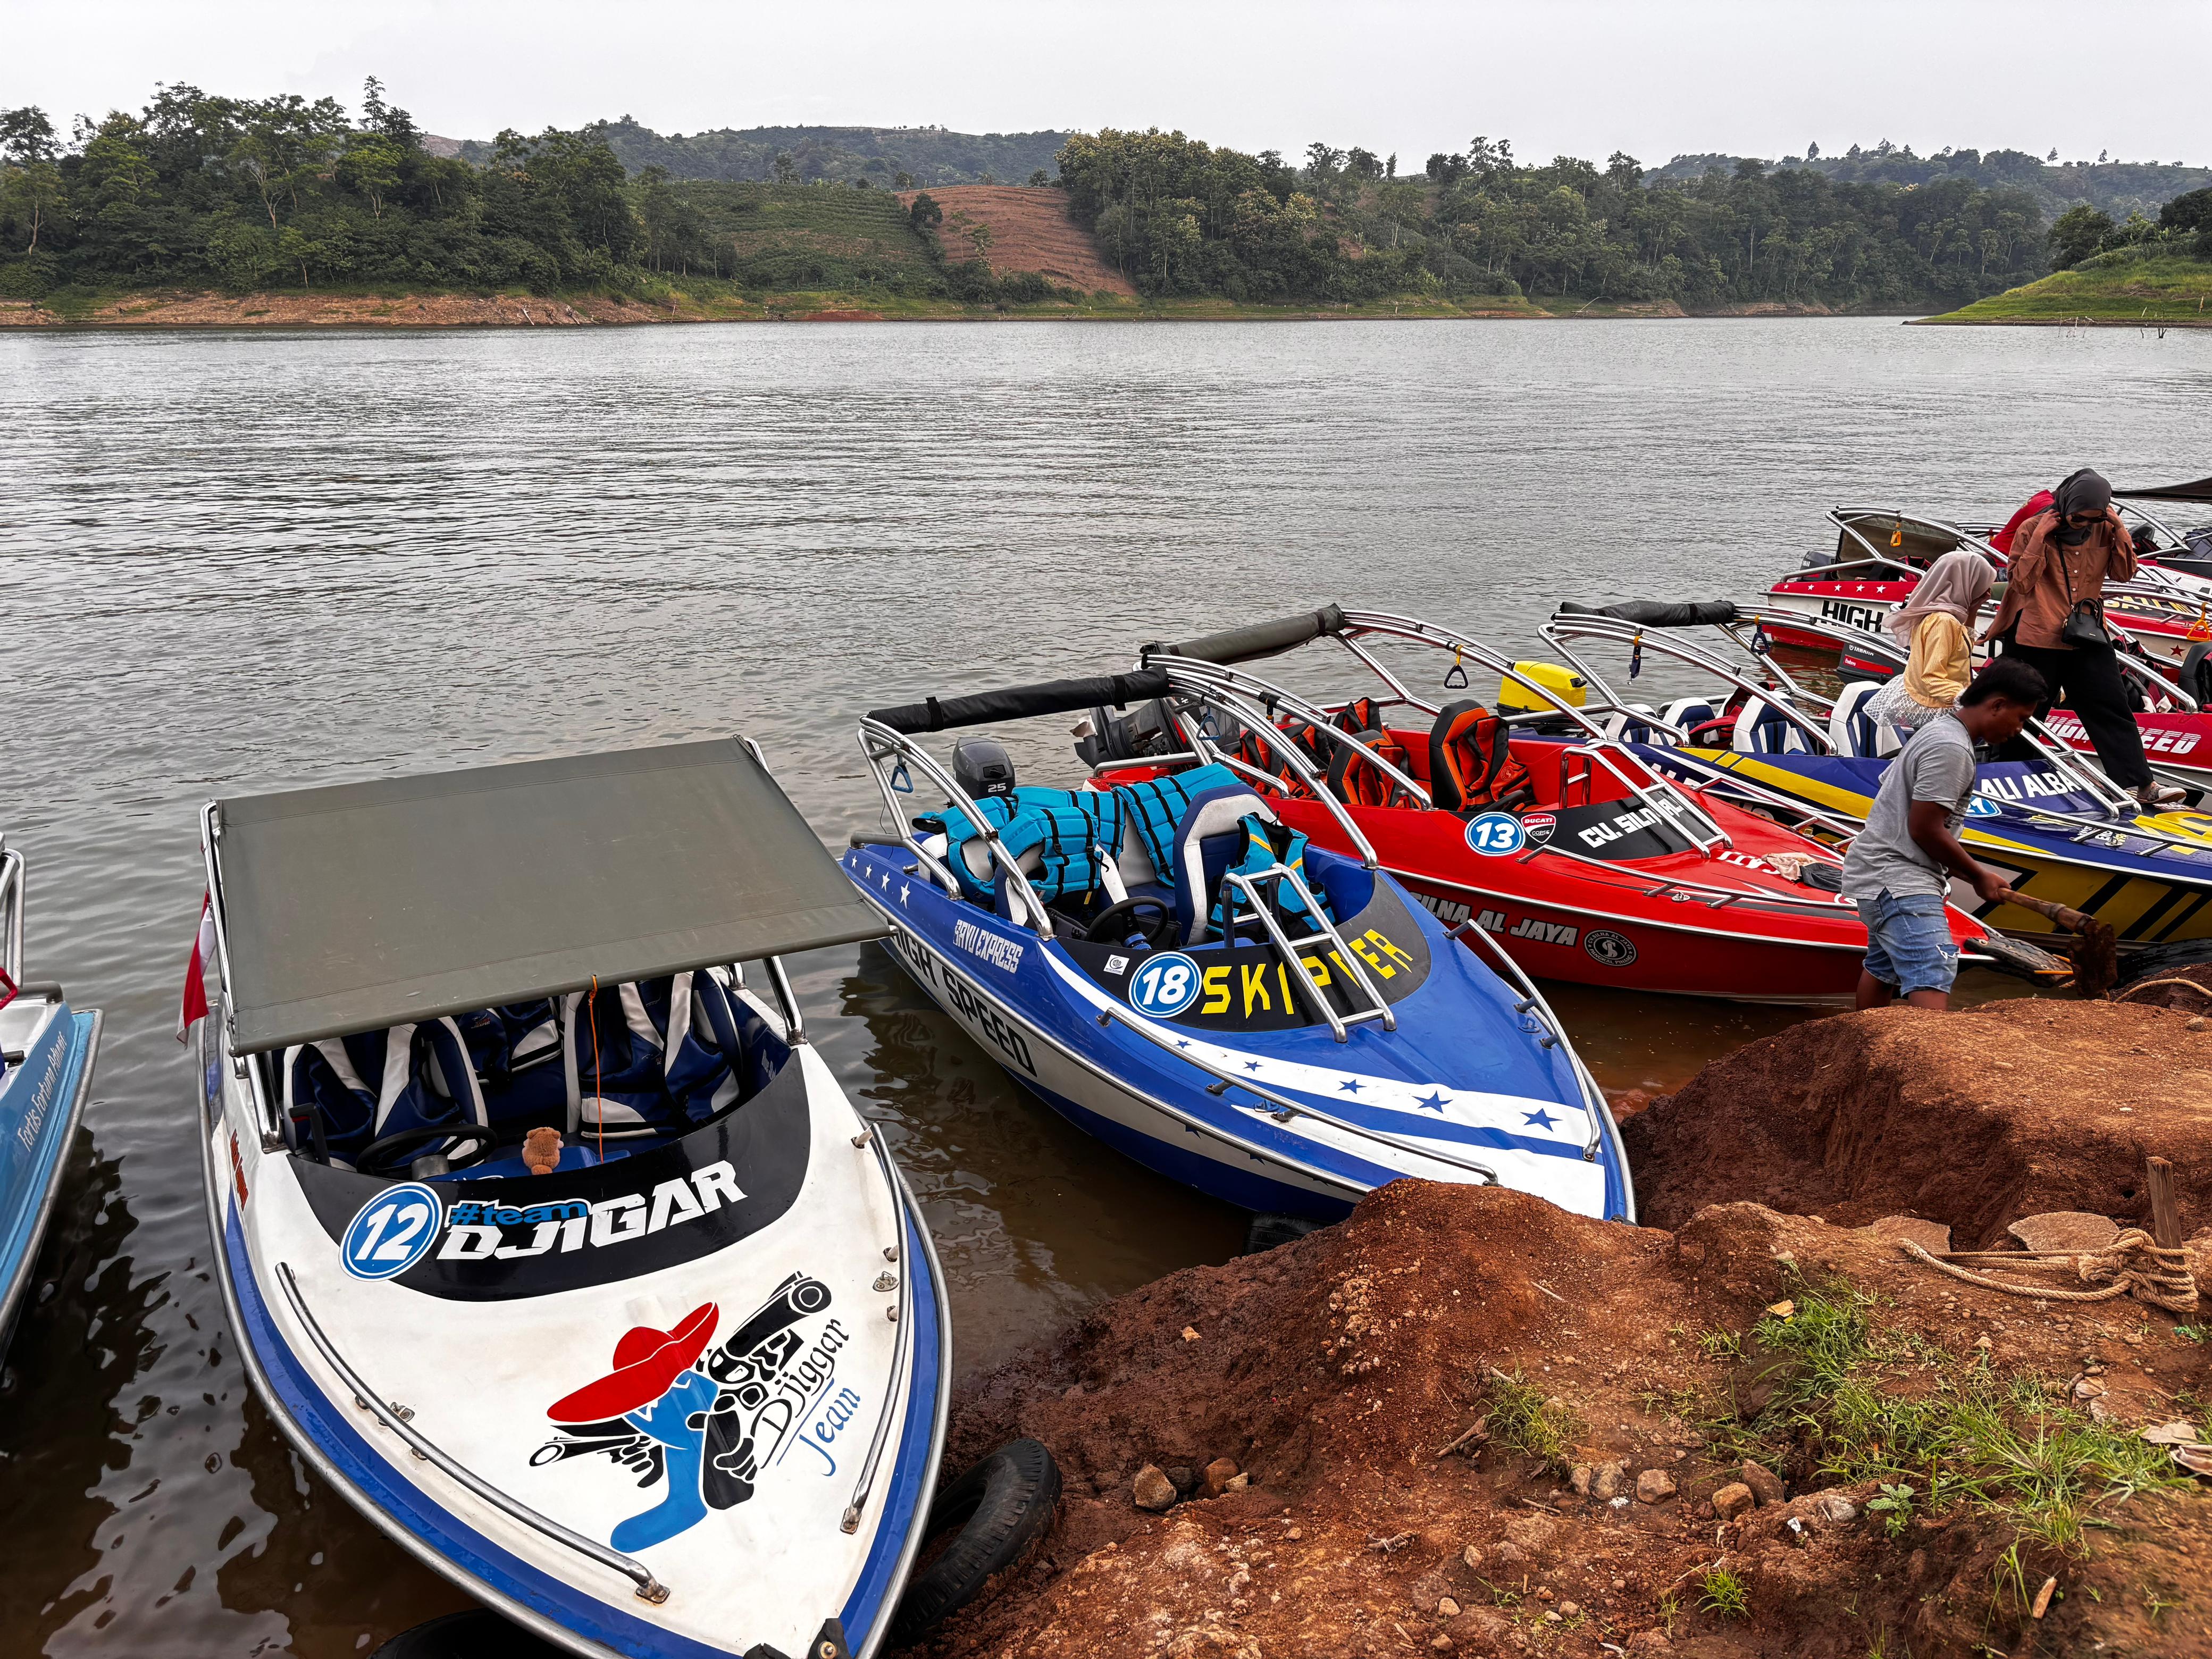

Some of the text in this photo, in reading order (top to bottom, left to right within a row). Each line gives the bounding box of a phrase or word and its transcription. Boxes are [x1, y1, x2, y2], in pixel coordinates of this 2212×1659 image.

[1821, 600, 1884, 632] HIGH
[2136, 726, 2201, 754] EED
[987, 782, 1007, 793] 25
[1981, 777, 2023, 800] ALI
[1476, 822, 1515, 849] 13
[1613, 807, 1663, 834] SILN
[1477, 909, 1505, 932] AL
[1510, 918, 1578, 946] JAYA
[975, 929, 1024, 974] EXPRESS
[1142, 966, 1190, 1005] 18
[942, 965, 1038, 1077] SPEED
[18, 1108, 41, 1152] Fortis
[436, 1160, 748, 1260] DJIGAR
[451, 1203, 587, 1226] #team
[354, 1203, 430, 1260] 12
[752, 1319, 849, 1469] Djiggar
